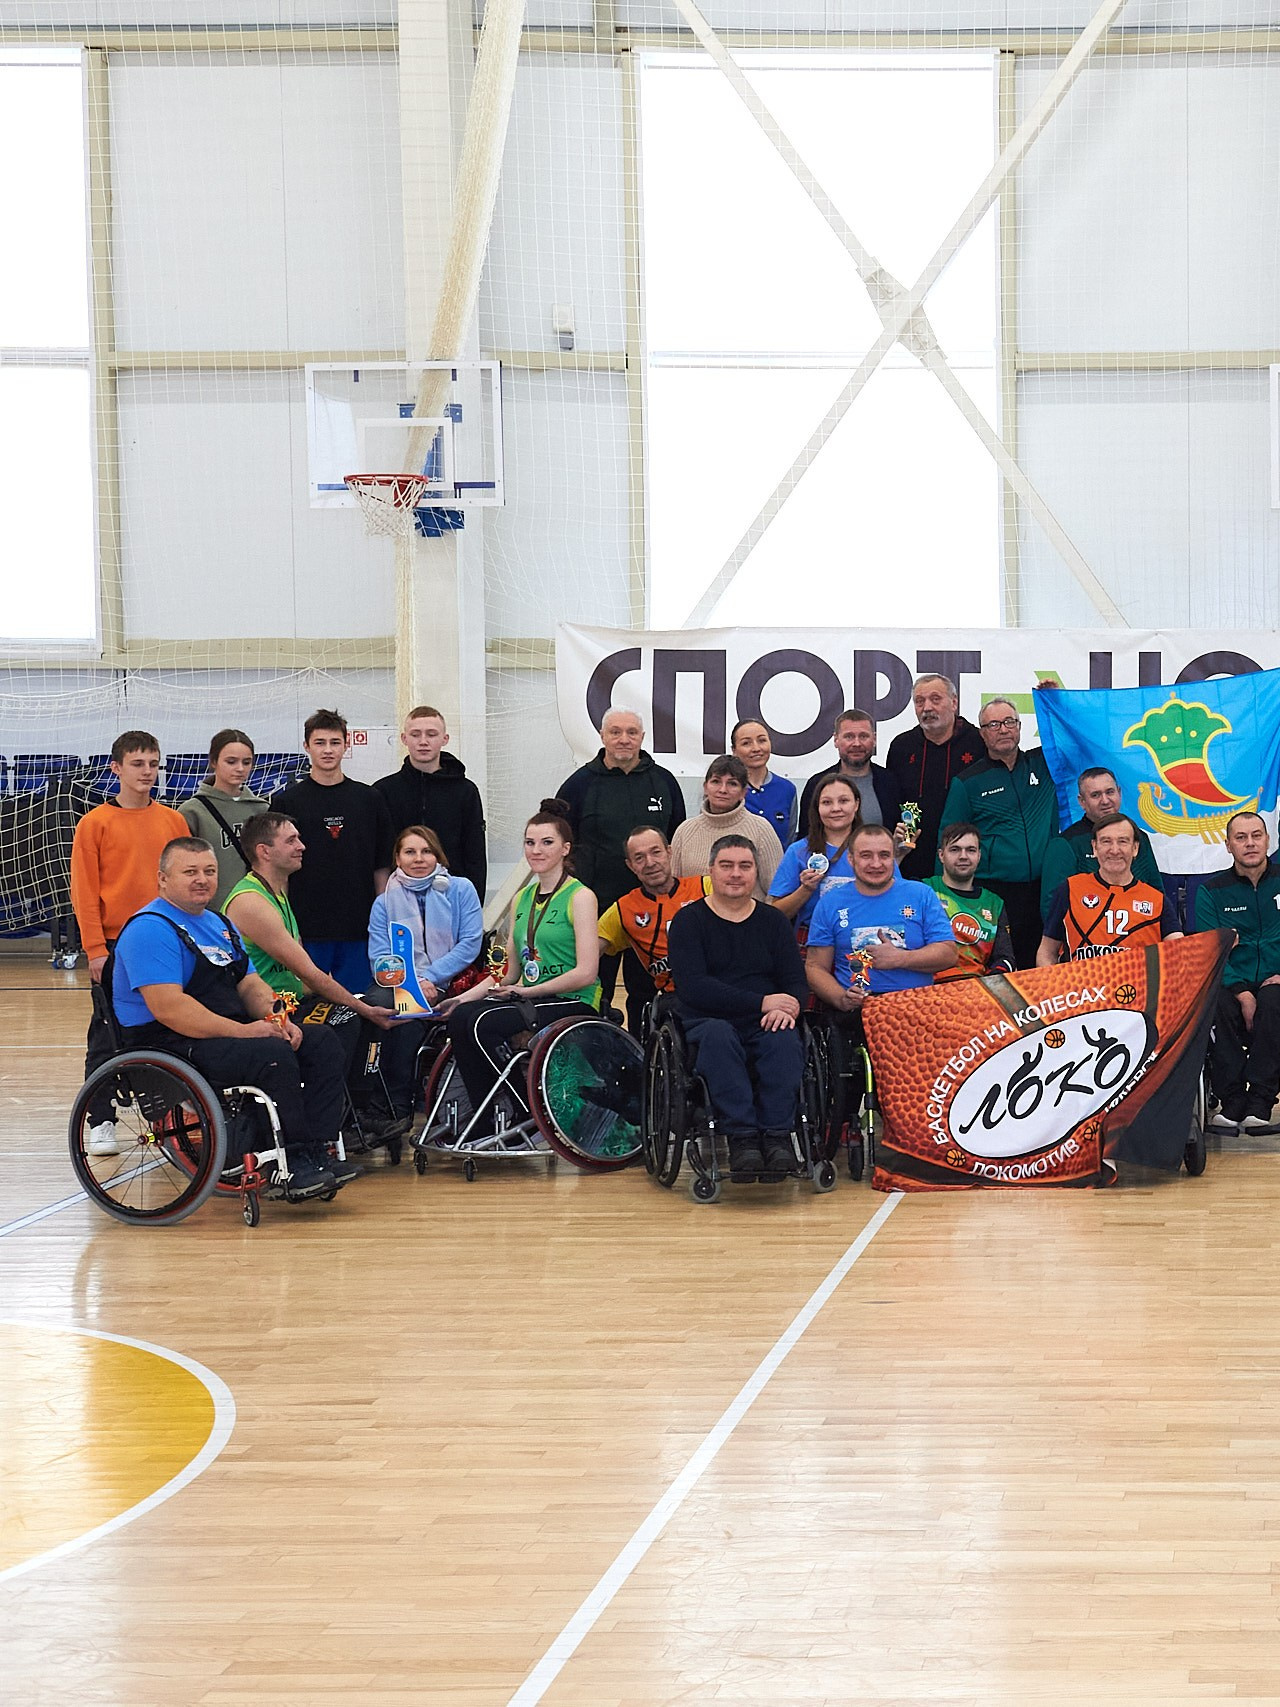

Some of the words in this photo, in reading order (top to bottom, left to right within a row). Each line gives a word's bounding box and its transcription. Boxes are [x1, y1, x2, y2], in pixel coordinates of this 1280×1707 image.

[1030, 772, 1039, 785] 4
[545, 910, 559, 924] 2
[1104, 909, 1129, 936] 12
[928, 1036, 986, 1145] БАСКЕТБОЛ
[983, 1018, 1014, 1043] НА
[1014, 985, 1107, 1028] КОЛЕСАХ
[959, 1042, 1131, 1134] ЛОКО
[970, 1137, 1081, 1181] ЛОКОМОТИВ
